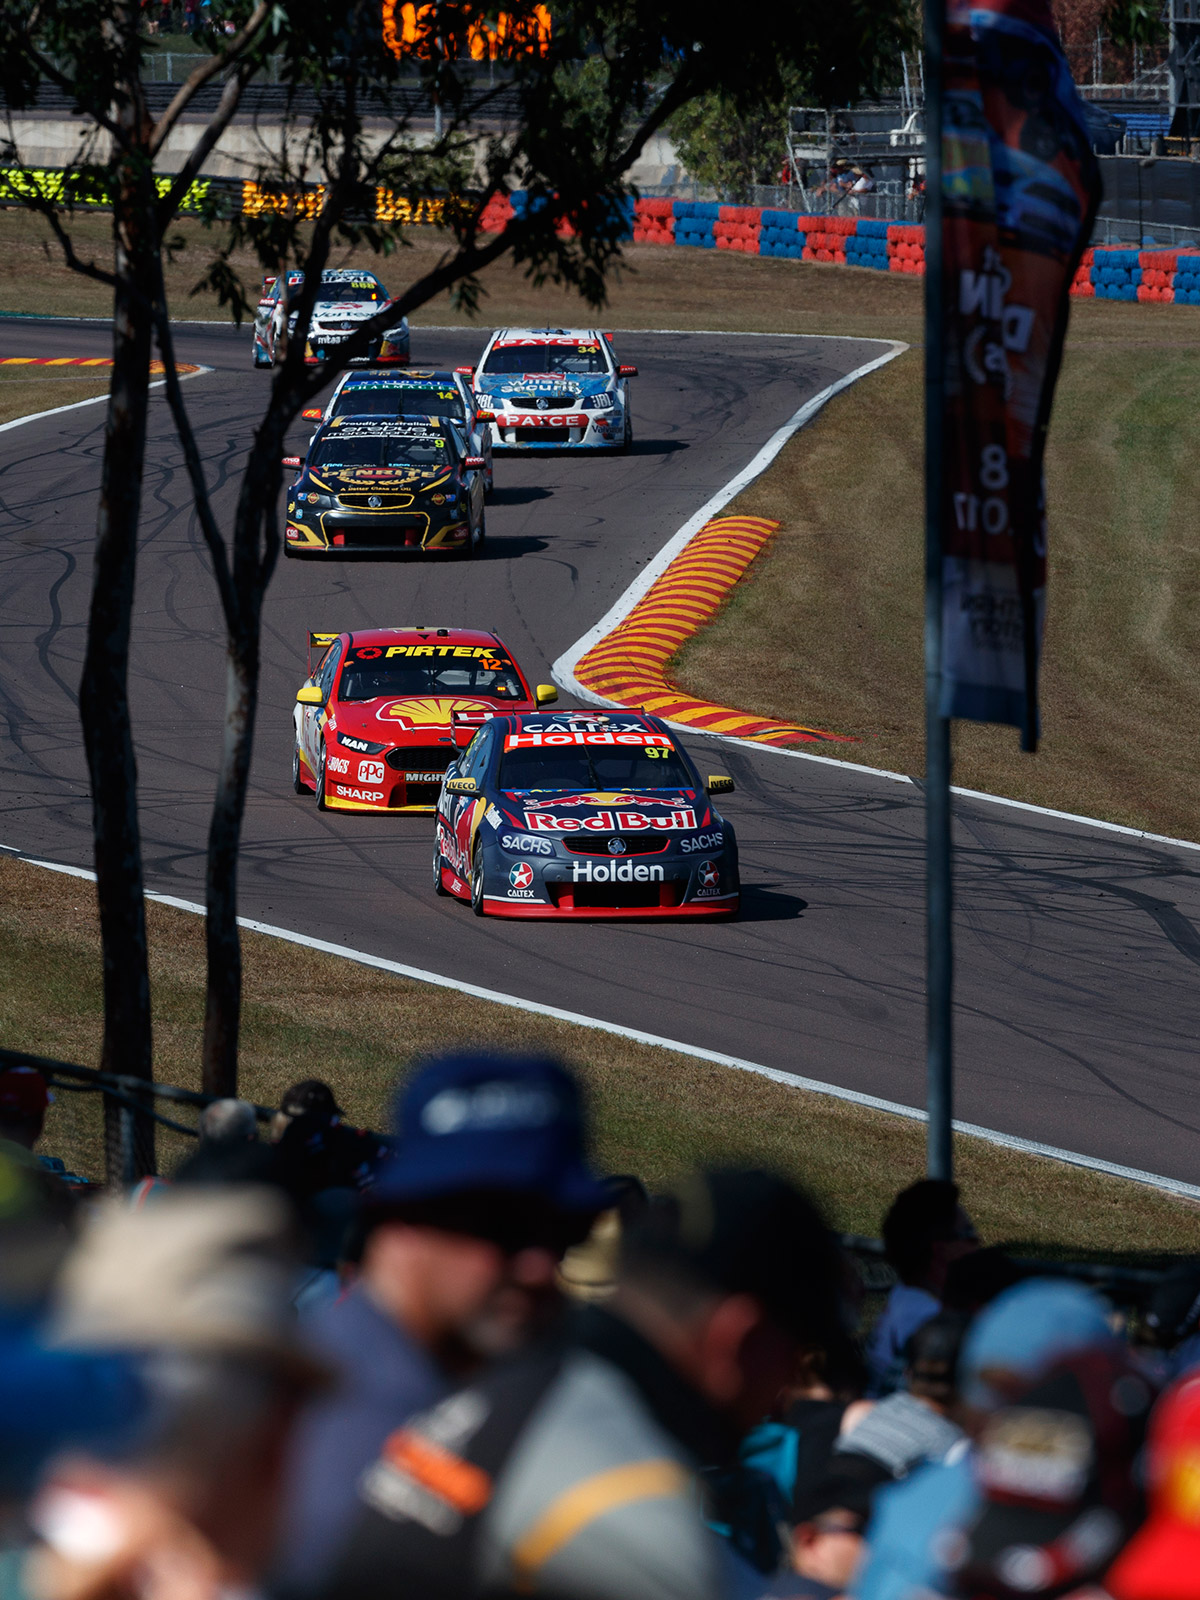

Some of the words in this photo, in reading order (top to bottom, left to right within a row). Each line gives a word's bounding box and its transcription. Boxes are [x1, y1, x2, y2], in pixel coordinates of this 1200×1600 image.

[578, 346, 597, 354] 34
[436, 391, 454, 400] 14
[506, 415, 579, 426] PAYCE
[434, 439, 444, 448] 9
[321, 469, 436, 478] PENRITE
[385, 646, 497, 658] PIRTEK
[479, 659, 503, 670] 12
[508, 733, 672, 747] Holden
[644, 748, 669, 759] 97
[450, 781, 476, 791] IVECO
[711, 779, 734, 789] IVECO
[336, 785, 384, 801] SHARP
[523, 811, 615, 831] Red
[615, 809, 697, 831] Bull
[501, 835, 552, 855] SACHS
[680, 831, 724, 853] SACHS
[573, 859, 664, 882] Holden
[507, 889, 535, 898] CALTEX
[696, 888, 721, 897] CALTEX
